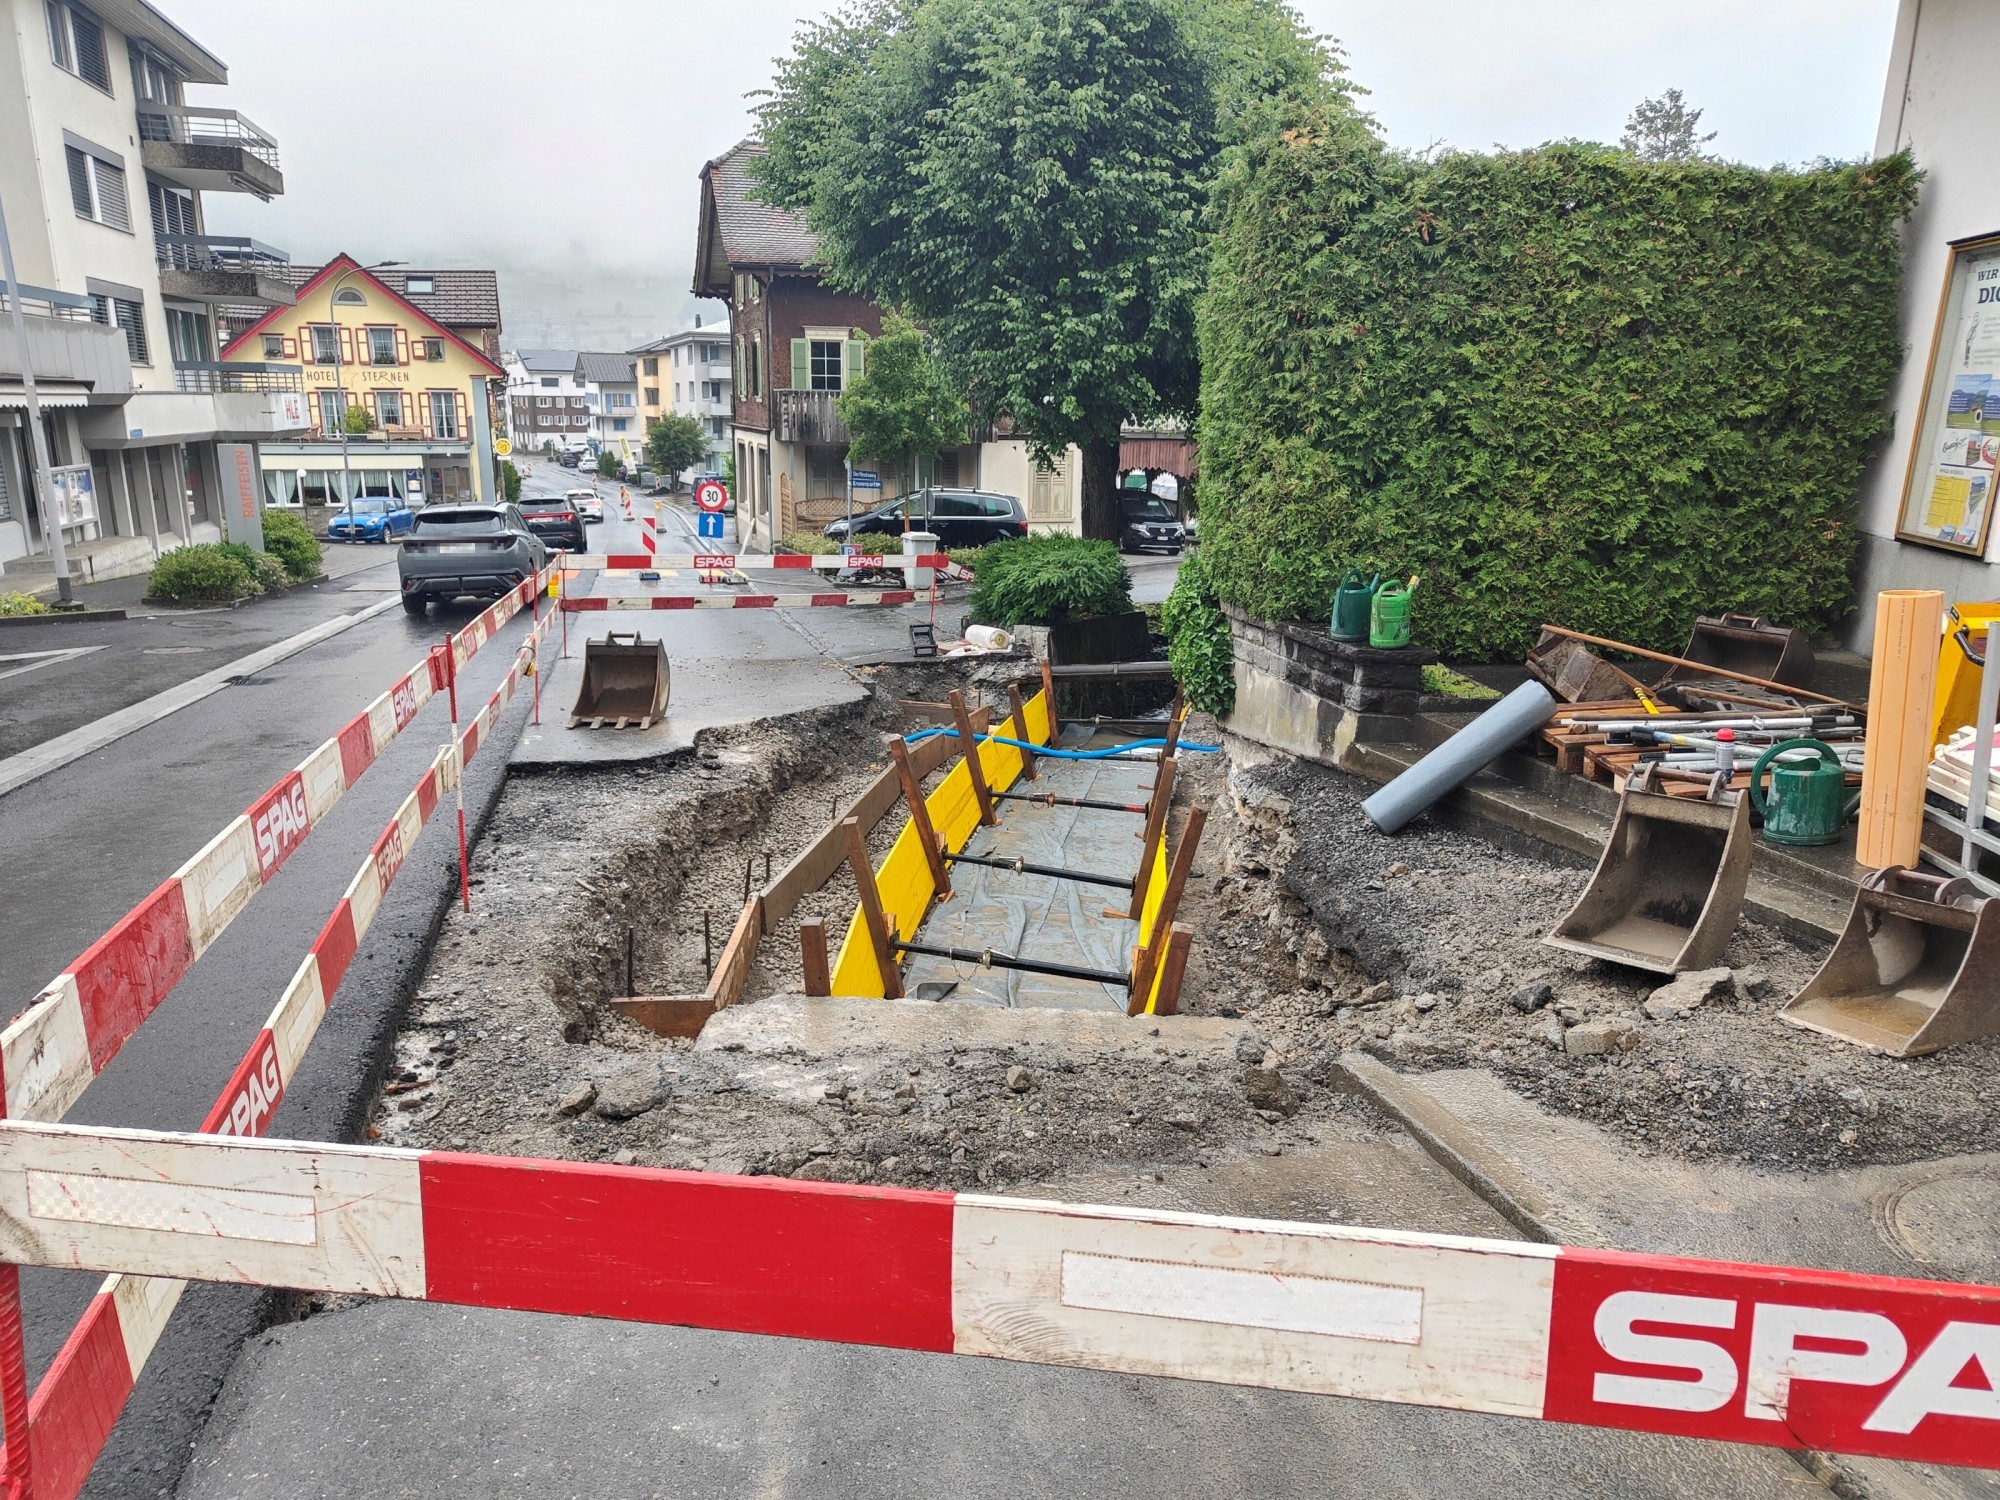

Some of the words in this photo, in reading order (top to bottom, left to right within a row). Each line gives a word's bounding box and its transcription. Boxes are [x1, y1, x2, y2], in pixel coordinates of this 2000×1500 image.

[1977, 268, 1998, 281] WIR
[306, 371, 337, 381] HOTEL
[362, 371, 409, 386] STERNEN
[235, 449, 255, 519] RAIFFEISEN
[705, 490, 718, 503] 30
[695, 556, 734, 568] SPAG
[849, 556, 883, 567] SPAG
[394, 679, 416, 725] SPAG
[256, 781, 308, 871] SPAG
[377, 828, 403, 890] SPAG
